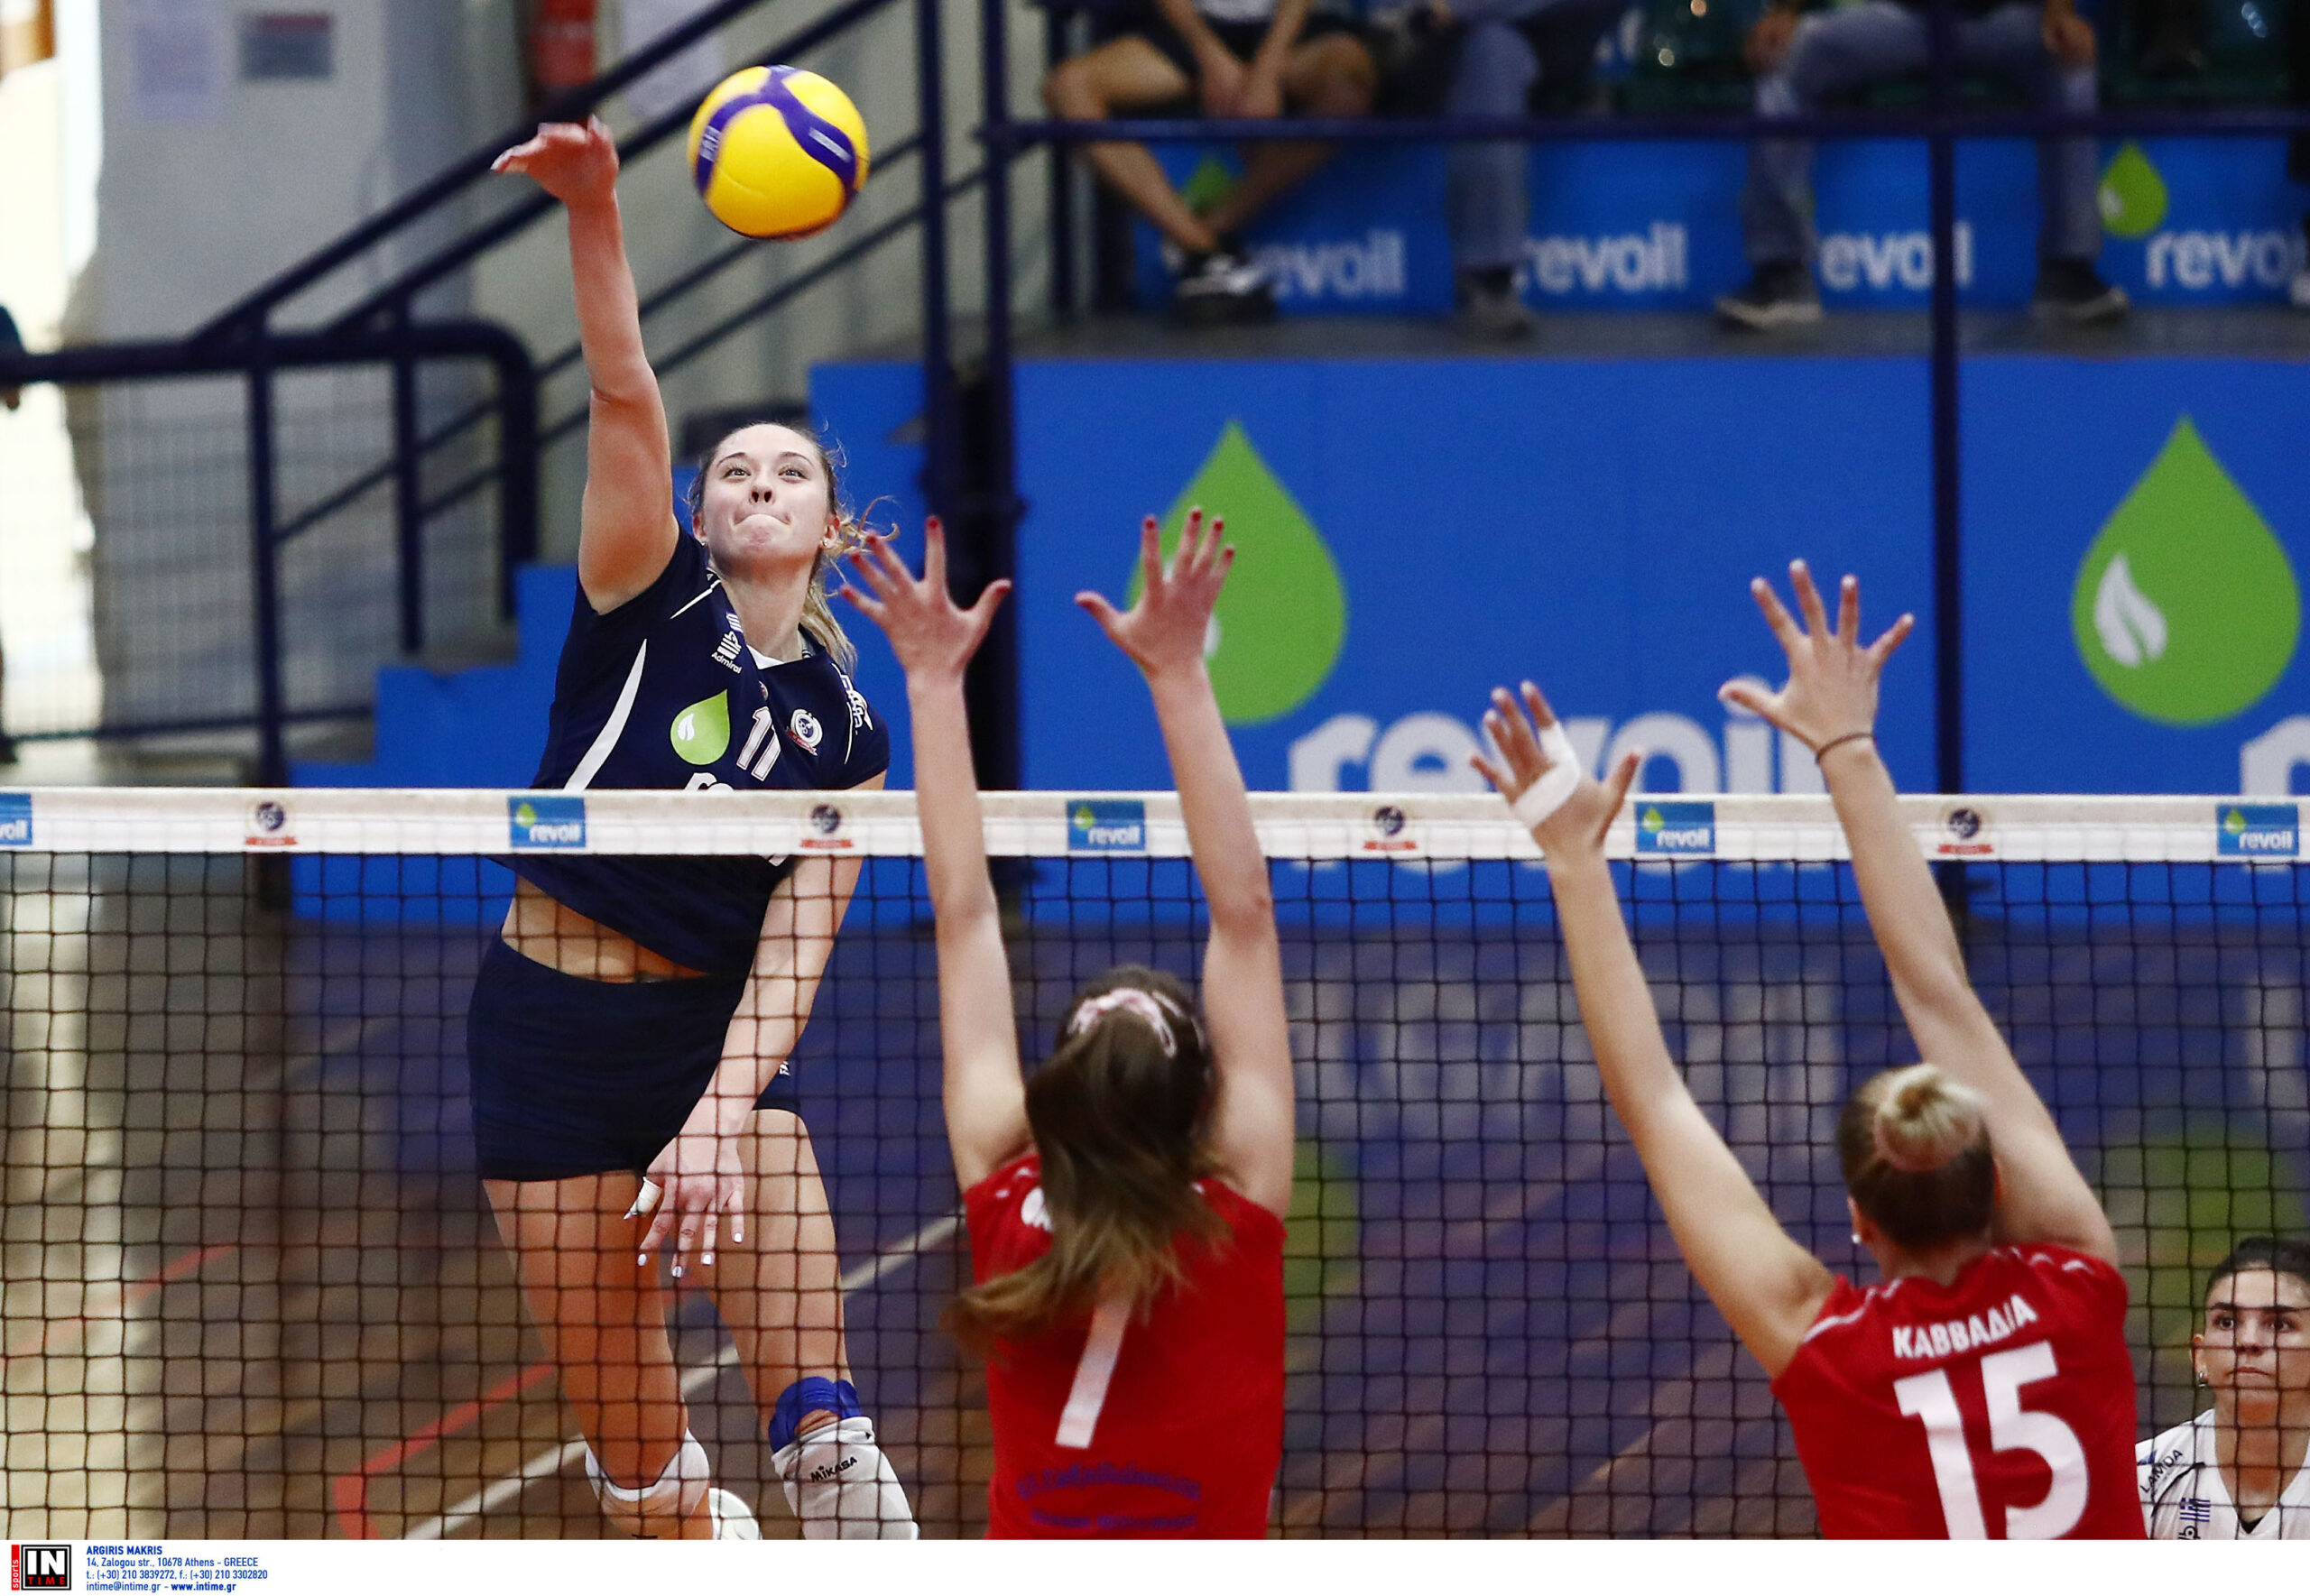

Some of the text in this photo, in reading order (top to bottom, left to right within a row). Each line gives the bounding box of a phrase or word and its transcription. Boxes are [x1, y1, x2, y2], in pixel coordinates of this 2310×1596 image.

[1250, 227, 1406, 296] evoil
[711, 651, 743, 674] Admiral
[0, 819, 28, 841] oil
[529, 822, 581, 843] revoil
[1088, 825, 1141, 844] revoil
[1657, 827, 1710, 847] revoil
[2239, 830, 2293, 850] revoil
[1893, 1340, 2090, 1541] 15
